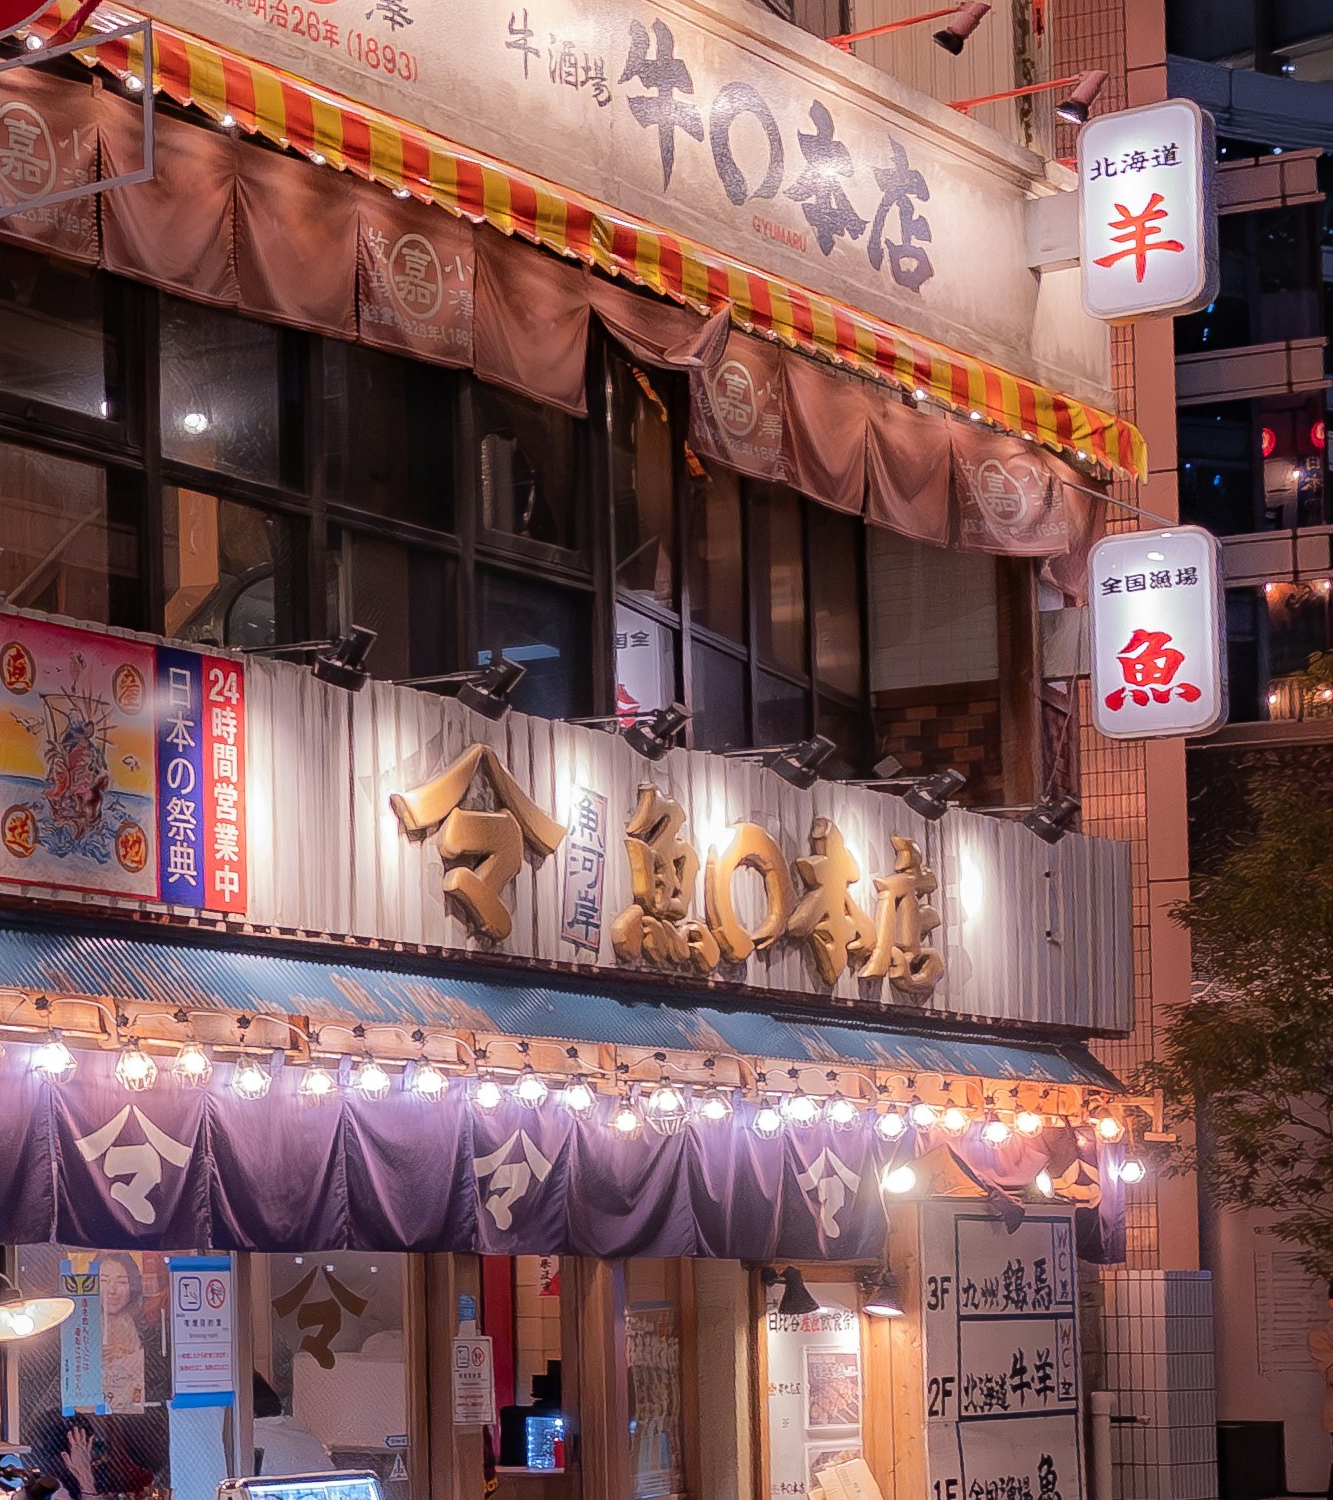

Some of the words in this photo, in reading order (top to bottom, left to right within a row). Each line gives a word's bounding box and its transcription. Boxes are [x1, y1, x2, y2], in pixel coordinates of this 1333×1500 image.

[505, 9, 609, 108] 牛酒場
[1088, 142, 1183, 183] 北海道
[751, 215, 808, 253] GYUMARU
[1094, 194, 1184, 284] 羊
[1100, 566, 1198, 598] 全国漁場
[1104, 628, 1201, 713] 魚
[165, 665, 198, 887] 日本の祭典
[208, 668, 240, 903] 24時間営業中
[564, 789, 606, 945] 魚河岸
[927, 1276, 951, 1311] 3F
[927, 1376, 956, 1418] 2F
[963, 1372, 1011, 1412] 北海道
